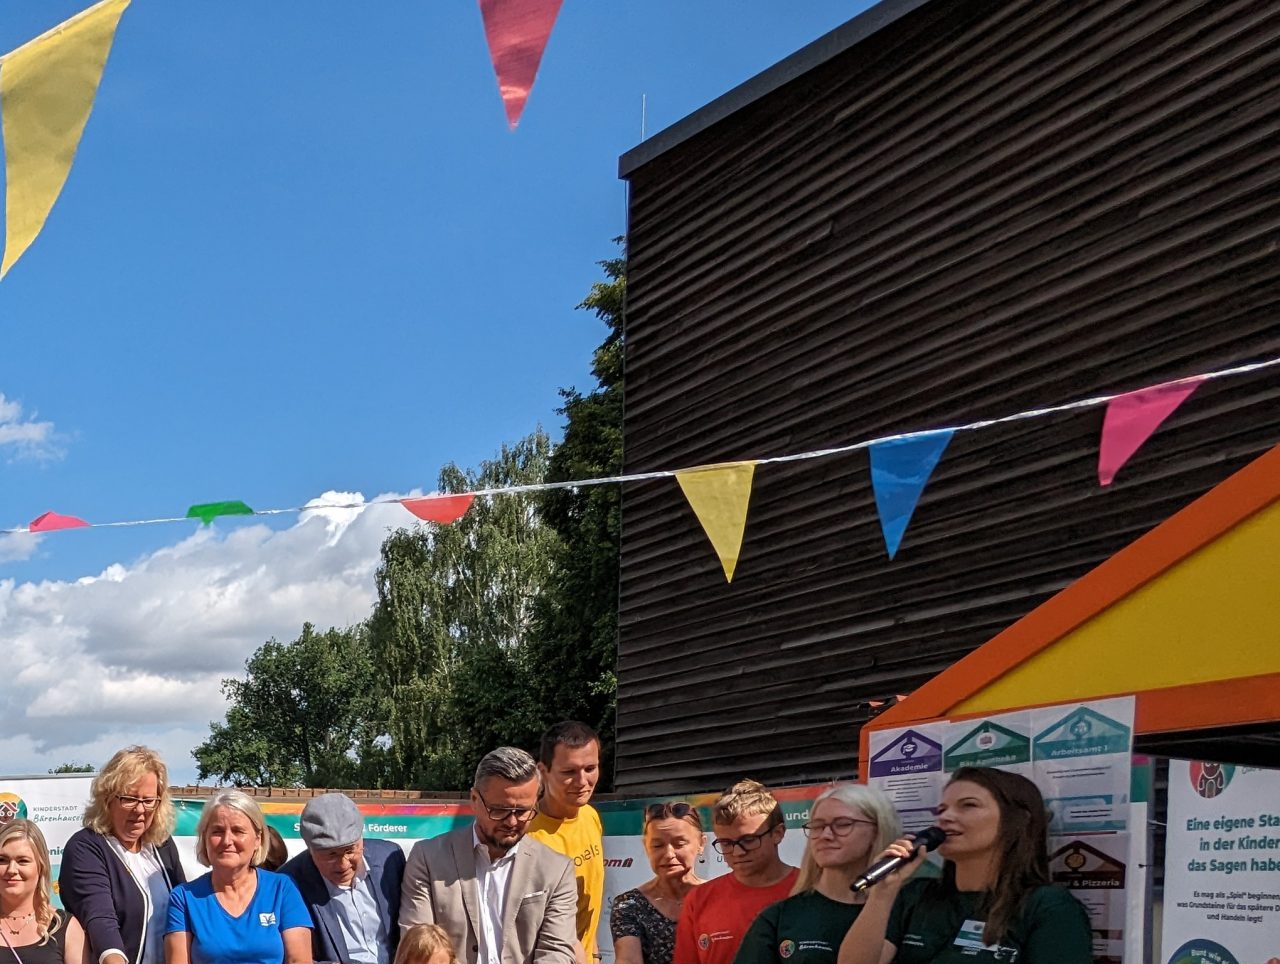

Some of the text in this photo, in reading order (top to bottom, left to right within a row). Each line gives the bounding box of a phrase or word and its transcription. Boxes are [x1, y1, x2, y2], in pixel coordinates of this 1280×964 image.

[890, 763, 929, 773] Akademie
[785, 809, 809, 821] und
[369, 823, 407, 833] Förderer
[1186, 817, 1210, 831] Eine
[1213, 815, 1255, 832] eigene
[1199, 837, 1210, 851] in
[1213, 837, 1235, 851] der
[1187, 858, 1207, 872] das
[1209, 858, 1247, 875] Sagen
[1082, 879, 1120, 887] Pizzeria
[1189, 901, 1225, 909] Grundsteine
[1247, 903, 1274, 912] spätere
[1208, 952, 1221, 962] wie
